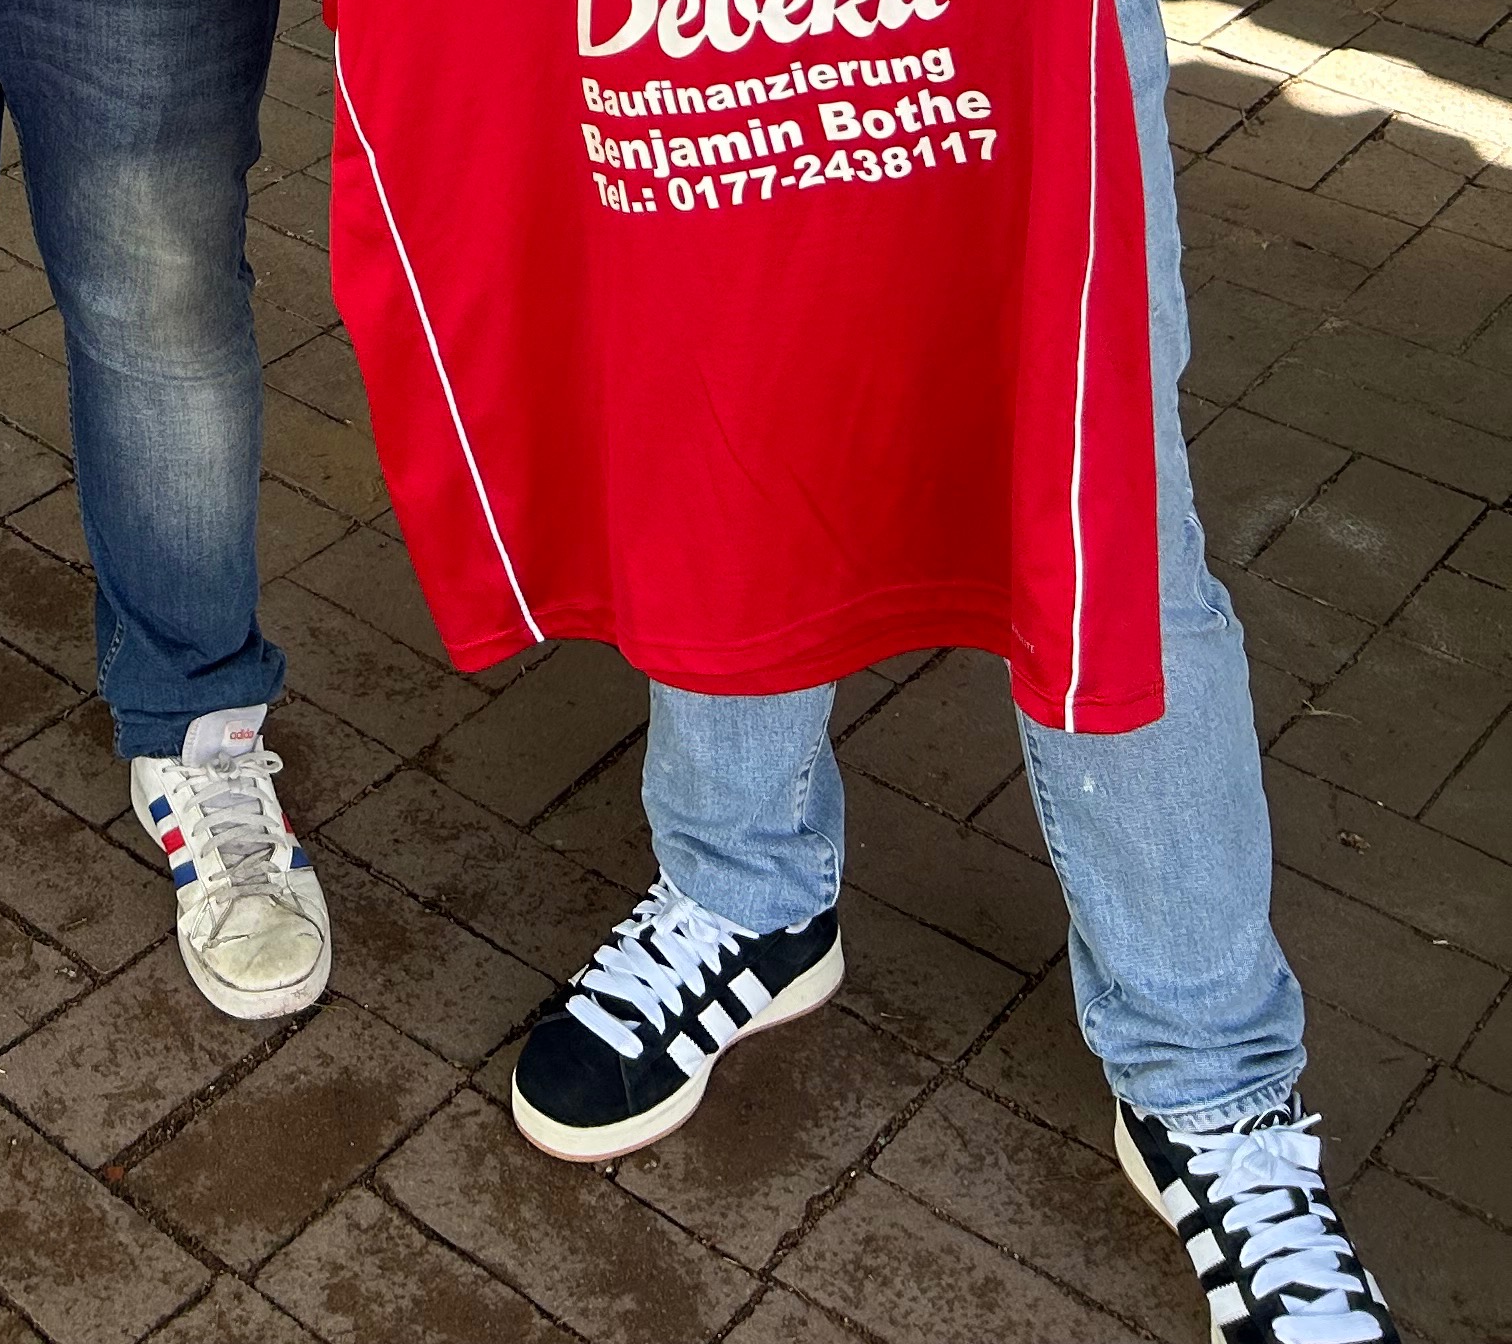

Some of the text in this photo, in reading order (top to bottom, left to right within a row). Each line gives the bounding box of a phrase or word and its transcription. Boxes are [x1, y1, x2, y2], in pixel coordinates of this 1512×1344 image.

[582, 47, 955, 118] Baufinanzierung
[581, 89, 992, 179] Benjamin Bothe
[592, 128, 998, 214] Tel.: 0177-2438117
